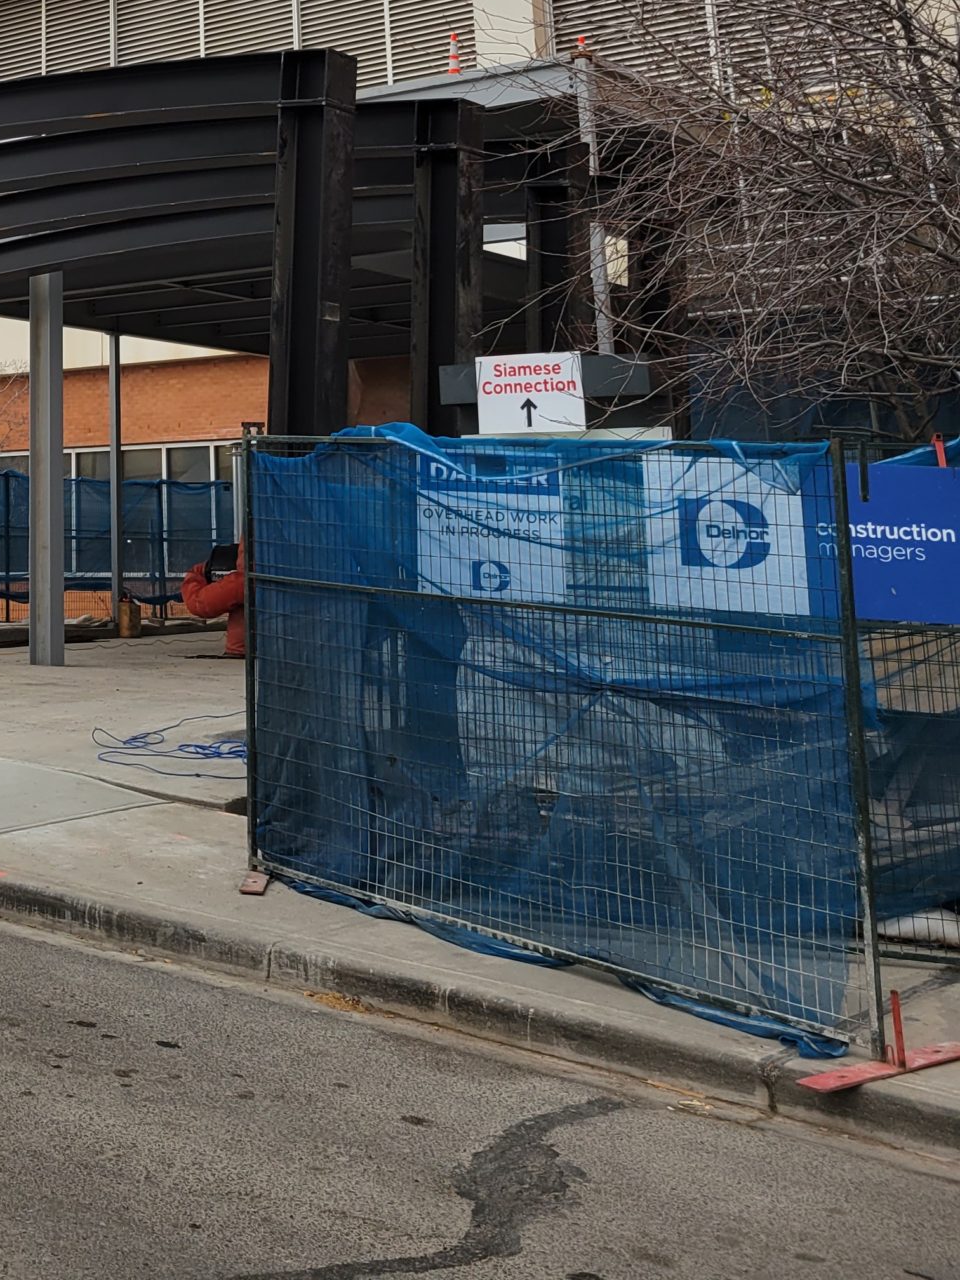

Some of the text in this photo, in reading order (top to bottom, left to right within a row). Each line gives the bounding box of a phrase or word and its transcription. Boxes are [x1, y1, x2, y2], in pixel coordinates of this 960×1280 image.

[493, 362, 562, 378] Siamese
[482, 378, 577, 395] Connection
[422, 507, 559, 525] OVERHEAD WORK
[440, 525, 456, 537] IN
[705, 524, 769, 541] Delnor
[819, 542, 926, 562] mnagers
